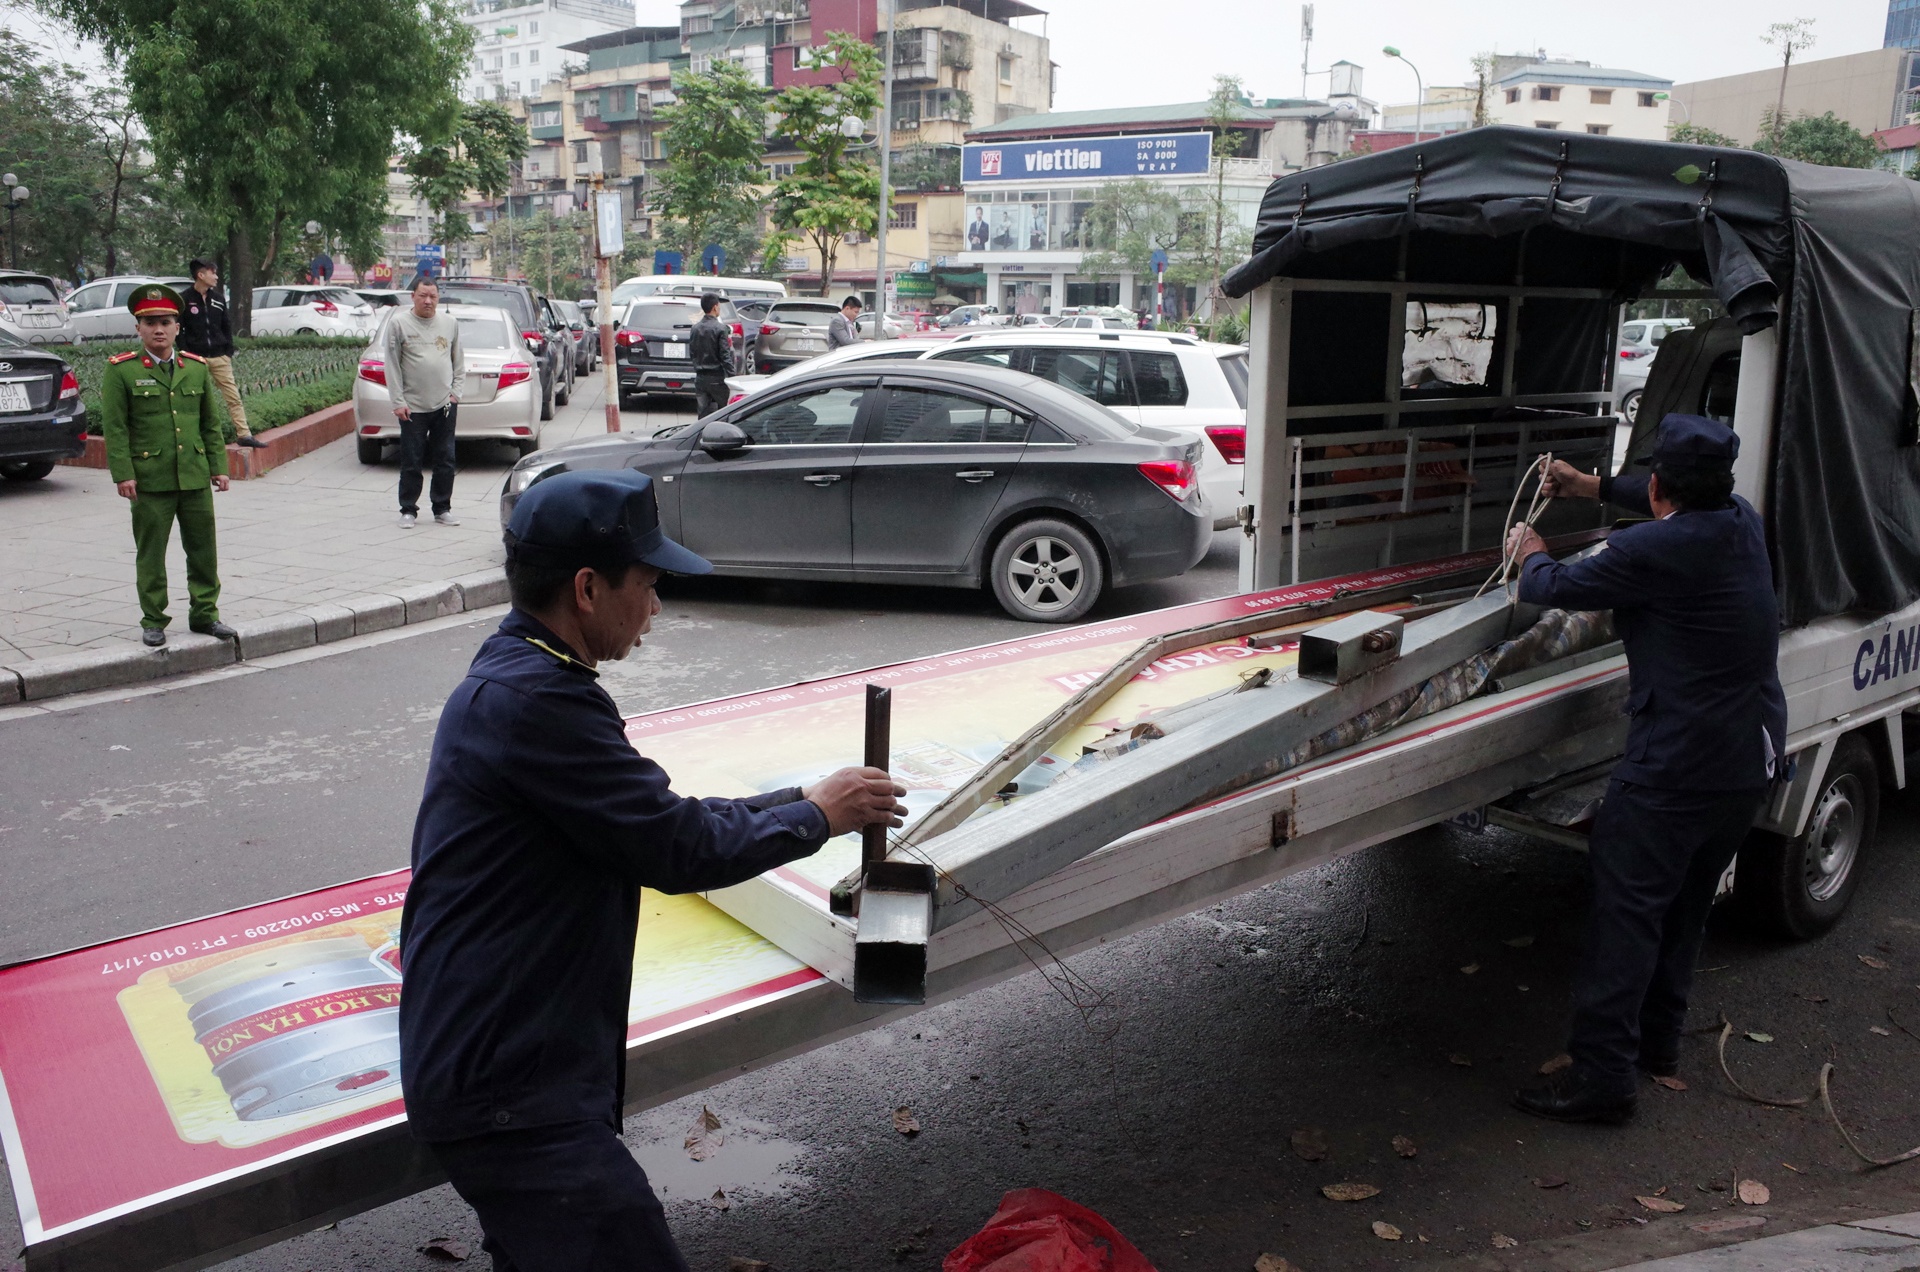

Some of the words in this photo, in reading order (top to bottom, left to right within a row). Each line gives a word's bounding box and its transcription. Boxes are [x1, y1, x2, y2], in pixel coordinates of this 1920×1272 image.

[1137, 141, 1153, 150] ISO
[1155, 140, 1176, 149] 9001
[1024, 148, 1102, 172] viettien
[1136, 152, 1149, 160] SA
[1155, 151, 1177, 160] 8000
[604, 202, 616, 244] P
[1002, 264, 1024, 272] viettien
[0, 385, 19, 398] 20A
[0, 397, 29, 410] 87.21
[1305, 587, 1331, 596] TEL:
[1084, 624, 1137, 639] HABECO
[1028, 631, 1088, 649] TRADING
[972, 651, 999, 661] CK:
[998, 646, 1022, 657] MÃ
[944, 656, 973, 667] HAT
[903, 664, 936, 674] TEL:
[812, 670, 902, 694] 04.3728.1476
[761, 693, 795, 703] MS:
[696, 700, 762, 717] 0102209
[654, 715, 686, 725] SV:
[244, 902, 361, 939] MS:0102209
[192, 935, 228, 951] PT:
[101, 945, 188, 975] 010.1/17
[311, 996, 373, 1019] HƠI
[256, 1011, 307, 1034] HÀ
[209, 1027, 255, 1057] NỘI
